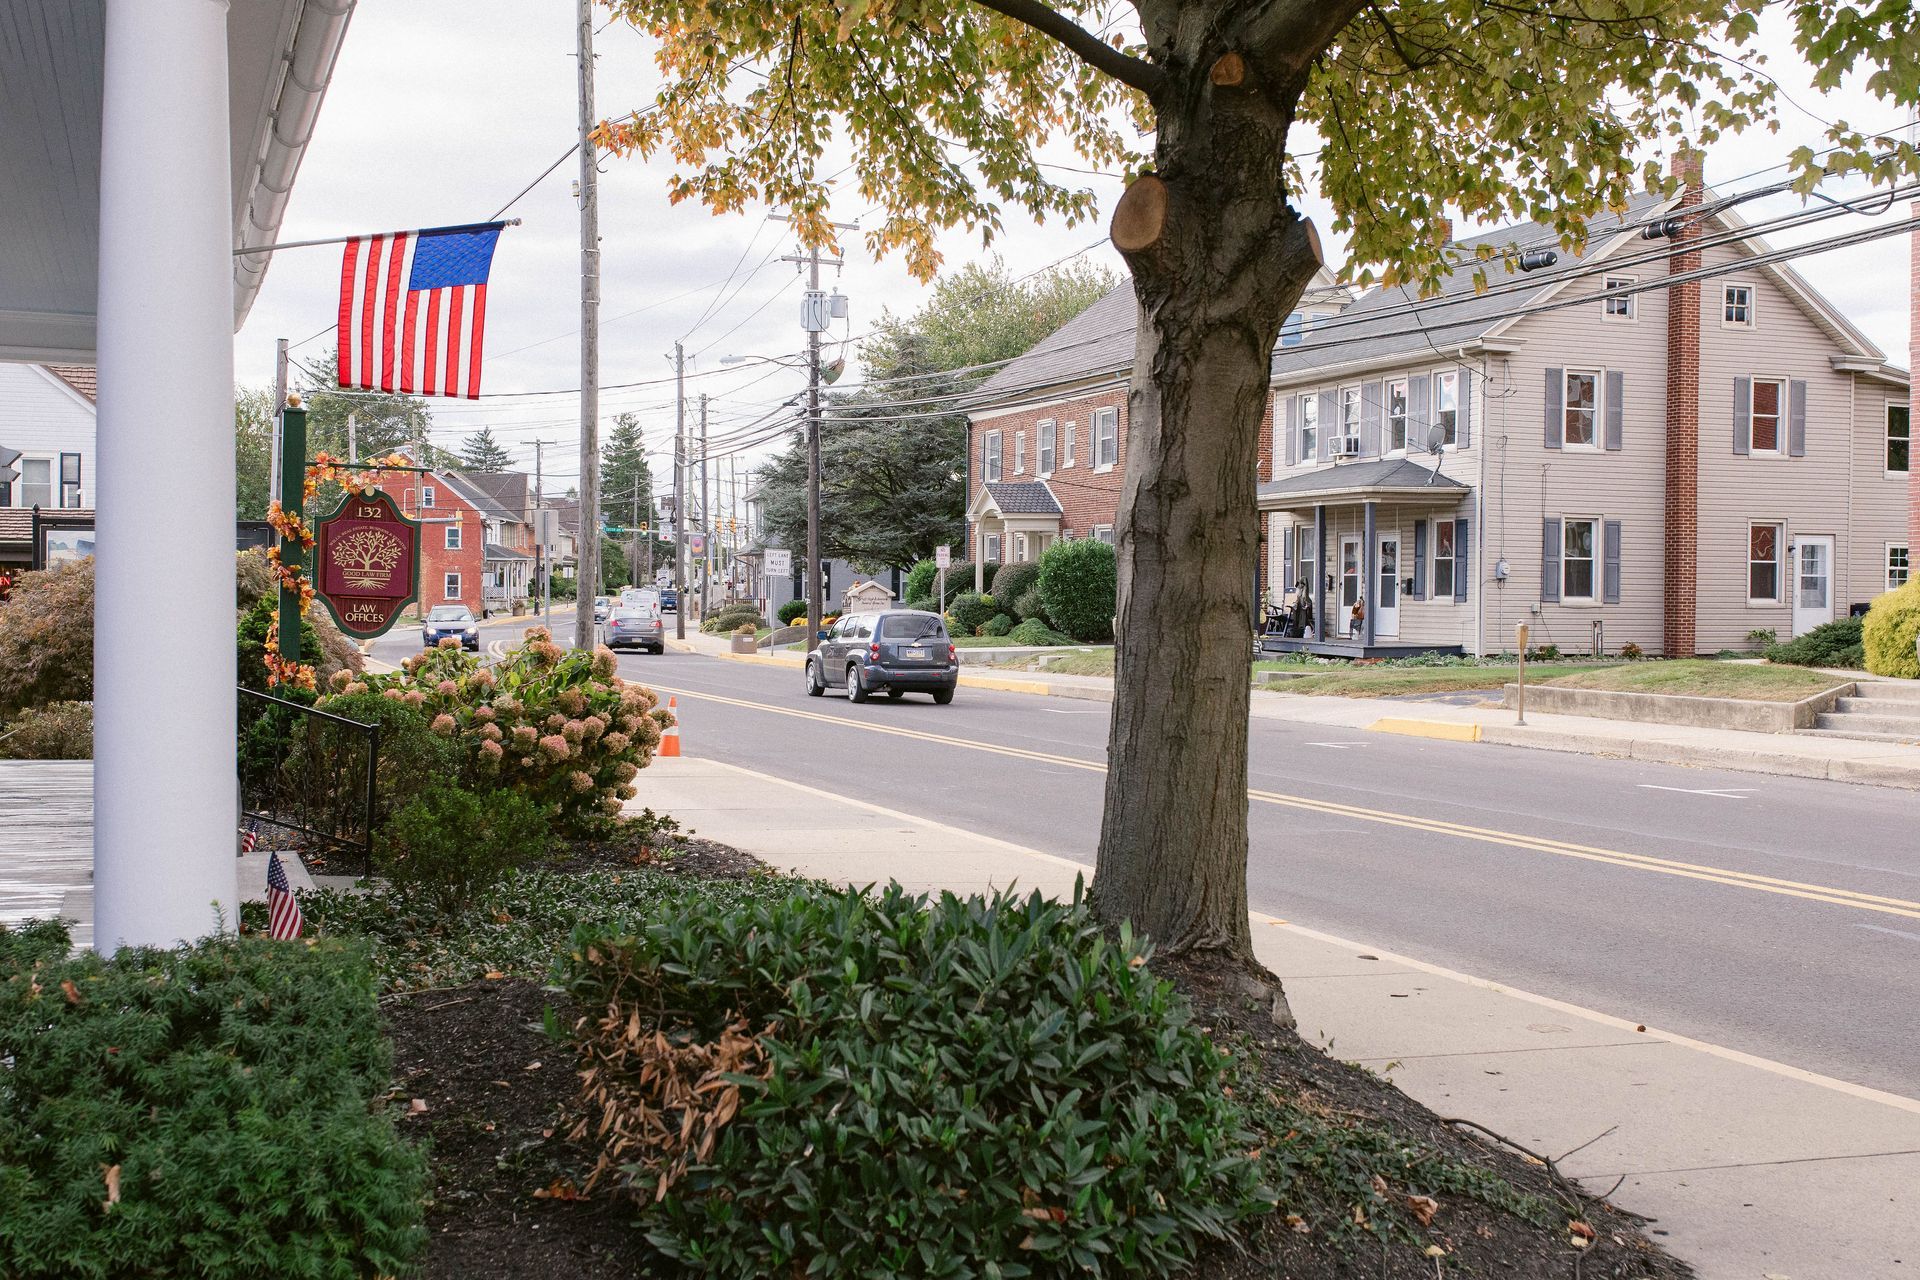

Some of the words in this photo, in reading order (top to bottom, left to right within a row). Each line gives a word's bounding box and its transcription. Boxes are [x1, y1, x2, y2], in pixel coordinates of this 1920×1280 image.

[357, 507, 382, 518] 132
[353, 604, 377, 613] LAW
[345, 612, 384, 623] OFFICES
